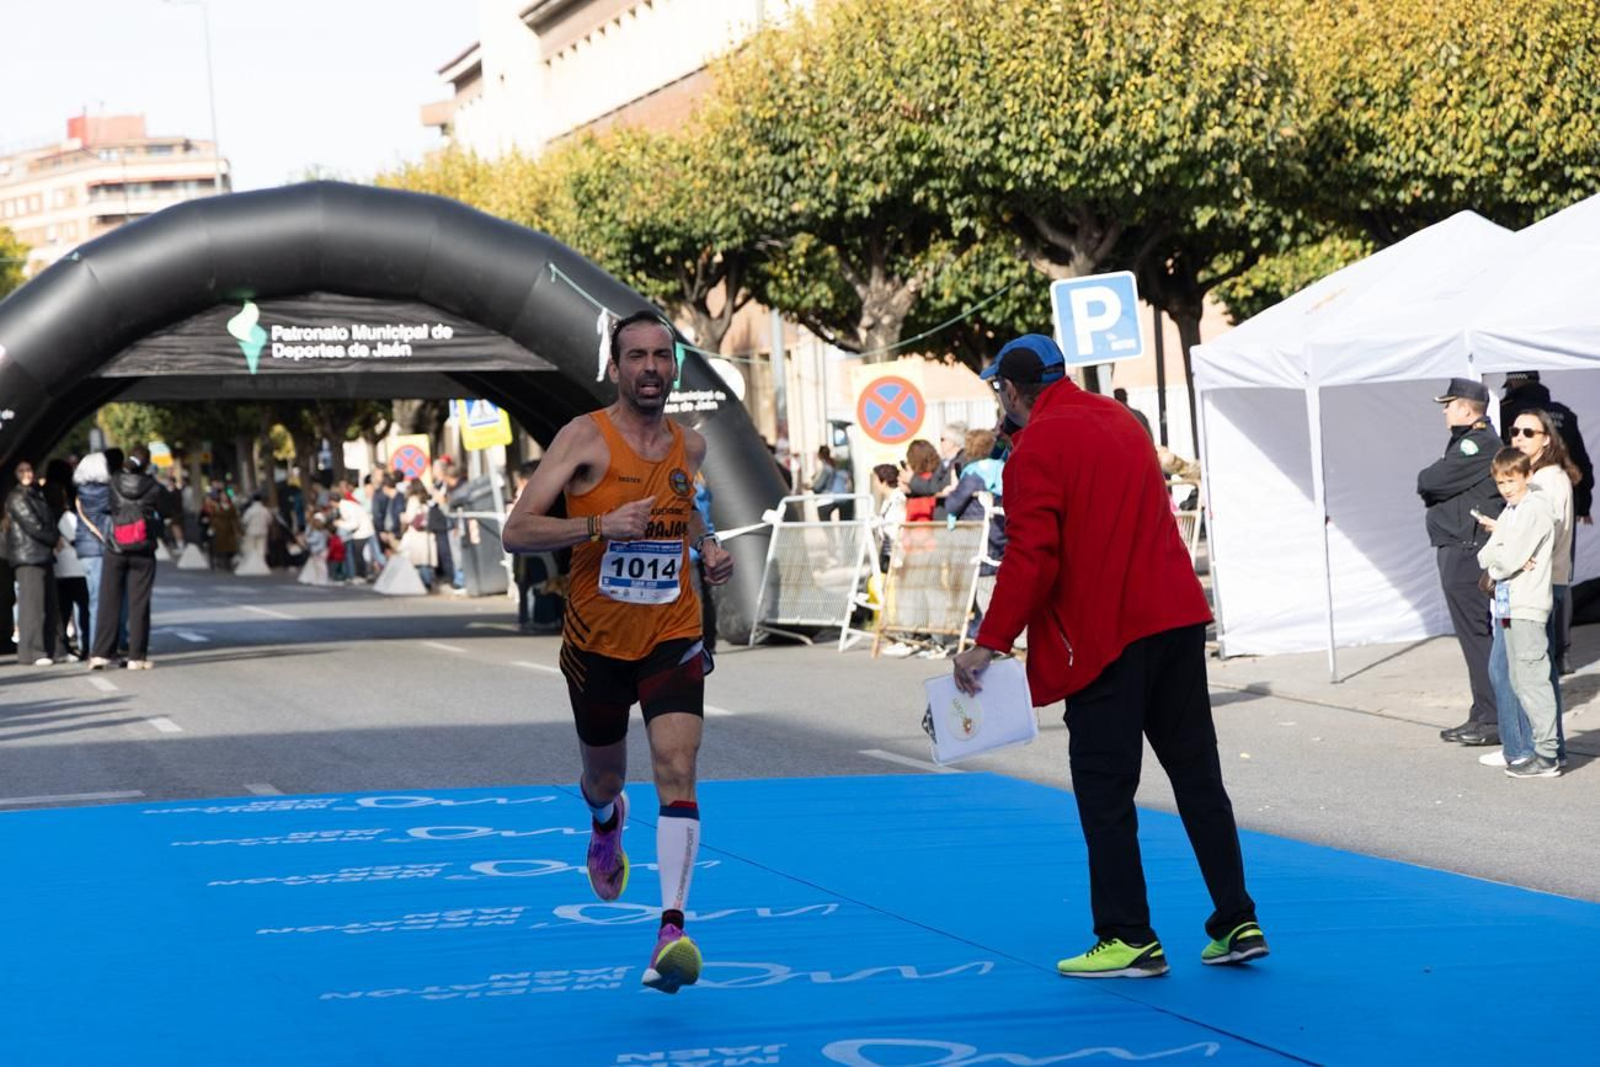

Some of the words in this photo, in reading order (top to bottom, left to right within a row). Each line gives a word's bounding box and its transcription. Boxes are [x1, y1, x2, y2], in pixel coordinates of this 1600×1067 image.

[1070, 286, 1121, 355] P
[271, 325, 348, 341] Patronato
[351, 323, 429, 342] Municipal
[431, 323, 453, 339] de
[271, 342, 345, 360] Deportes
[347, 342, 370, 357] de
[372, 341, 412, 358] Jaén
[611, 557, 676, 580] 1014
